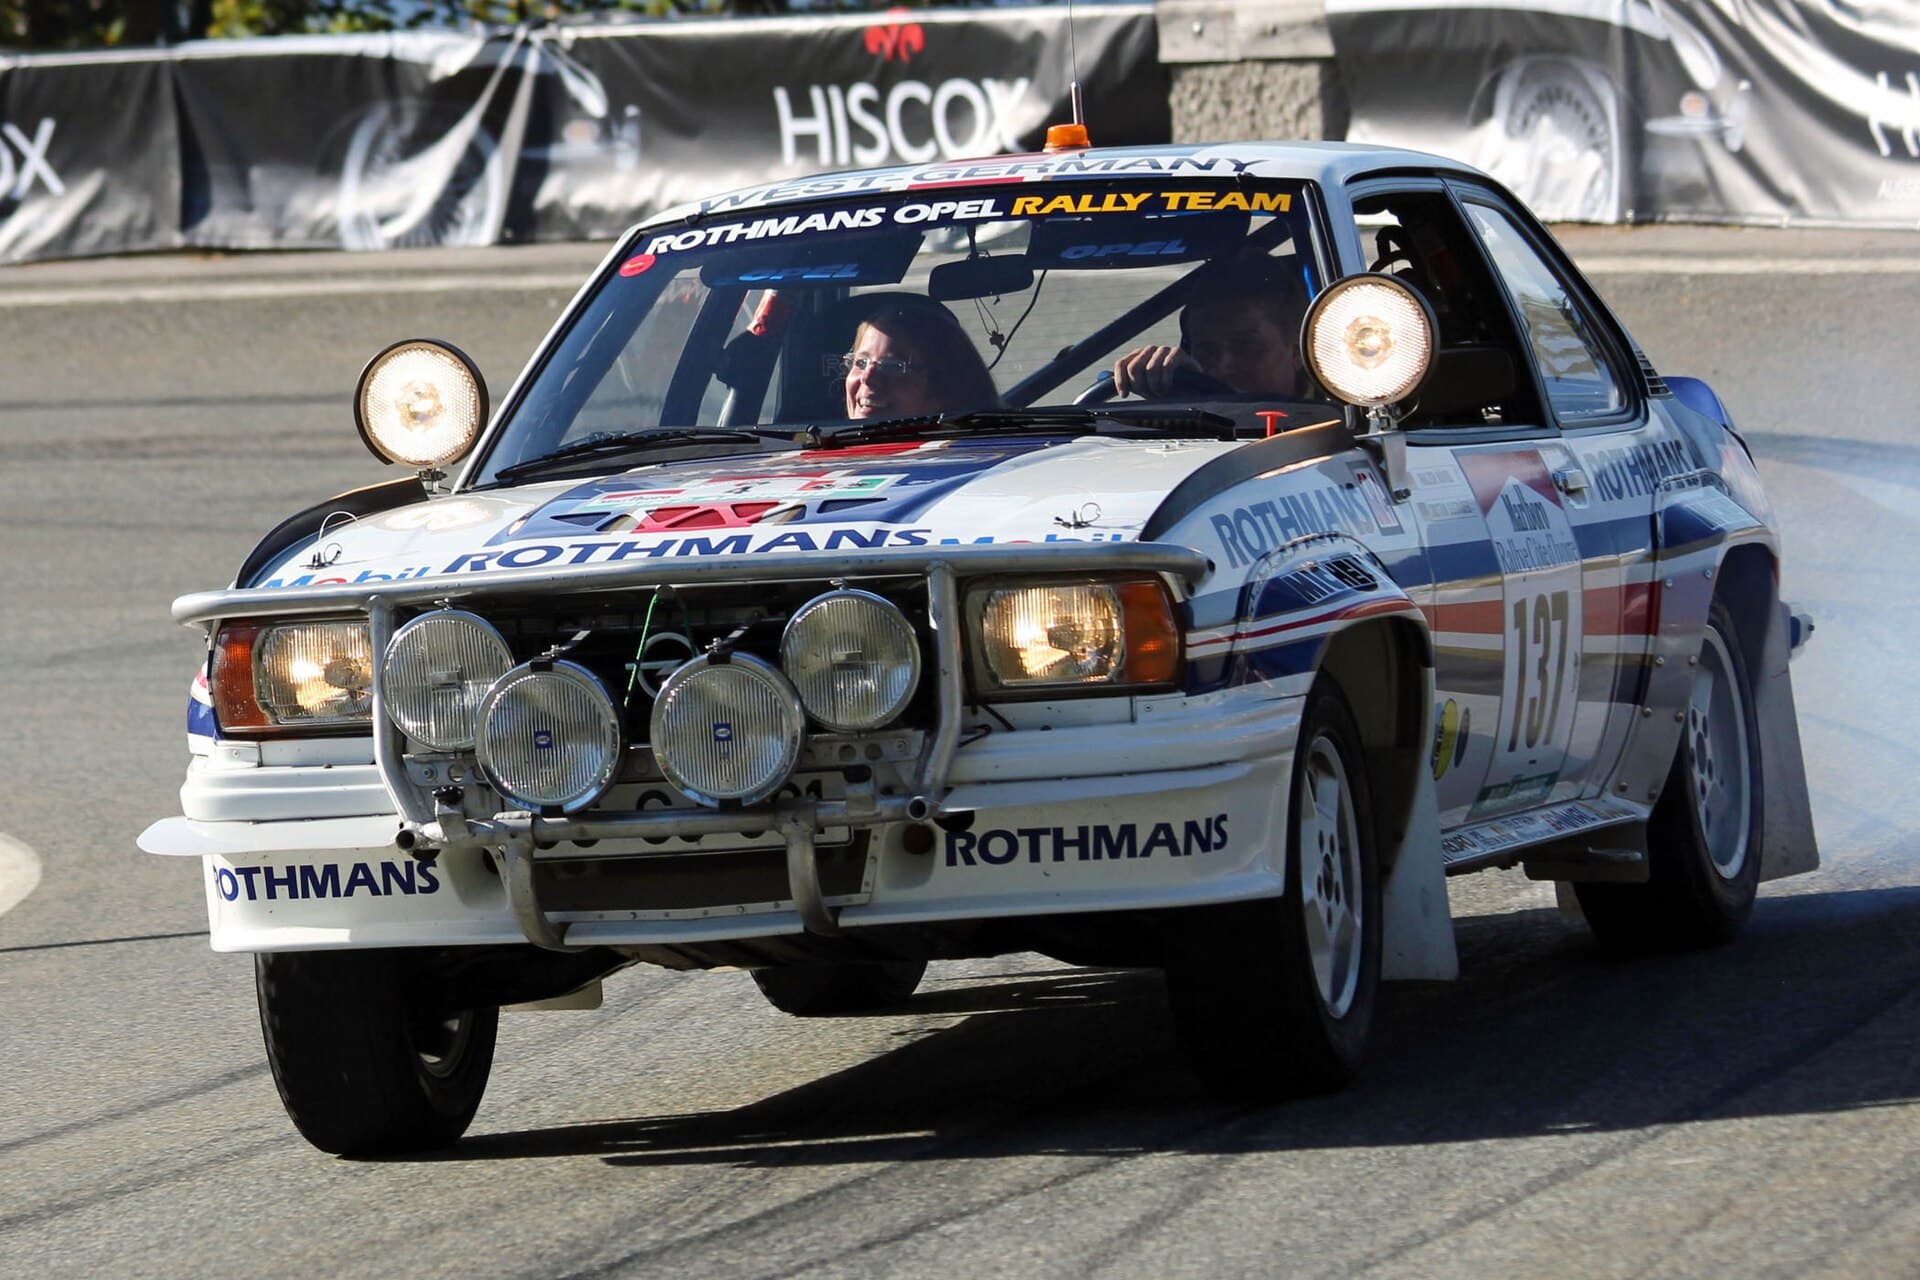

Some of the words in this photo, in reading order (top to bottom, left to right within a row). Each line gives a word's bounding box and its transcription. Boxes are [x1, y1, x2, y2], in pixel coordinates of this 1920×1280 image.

[774, 77, 1029, 166] HISCOX
[0, 117, 65, 200] X
[645, 208, 886, 255] ROTHMANS
[893, 199, 1004, 224] OPEL
[1011, 193, 1153, 216] RALLY
[1160, 192, 1292, 212] TEAM
[1060, 239, 1188, 259] OPEL
[738, 264, 860, 282] OPEL
[1582, 440, 1691, 502] ROTHMANS
[441, 529, 932, 574] ROTHMANS
[1210, 484, 1377, 570] ROTHMANS
[1507, 590, 1569, 753] 137
[945, 813, 1228, 867] ROTHMANS
